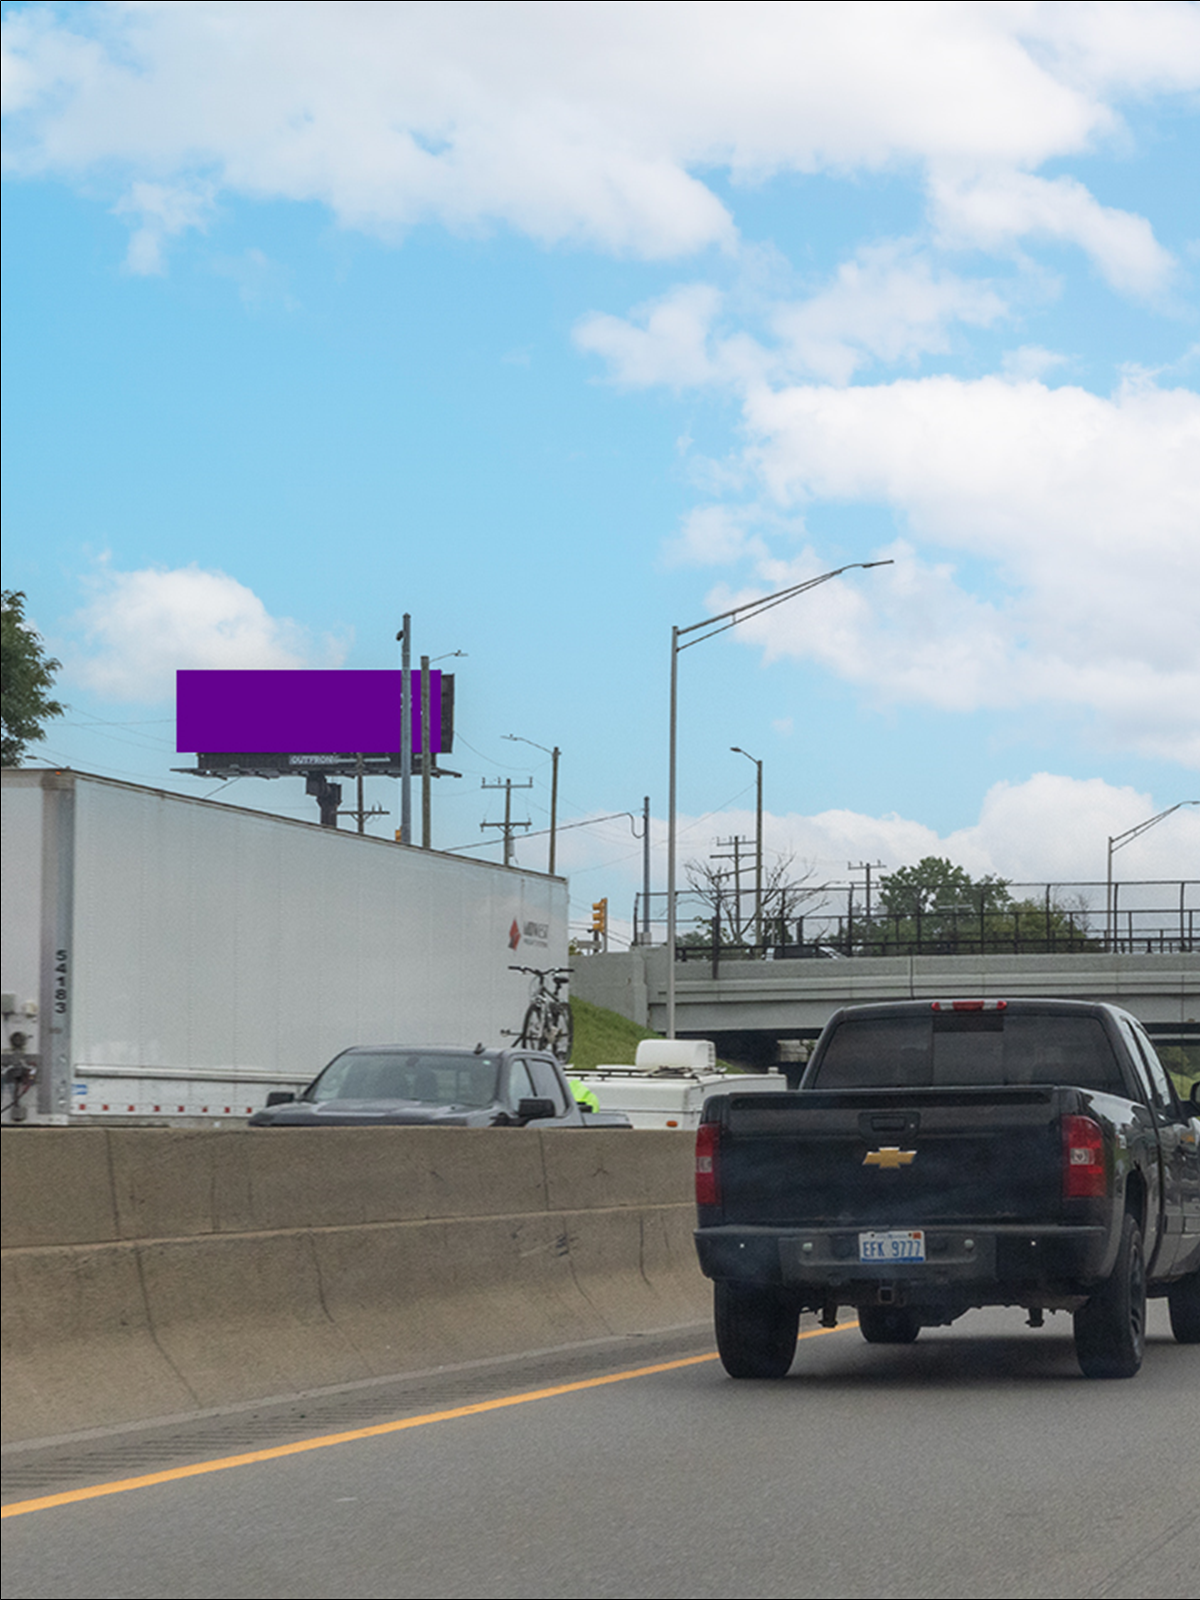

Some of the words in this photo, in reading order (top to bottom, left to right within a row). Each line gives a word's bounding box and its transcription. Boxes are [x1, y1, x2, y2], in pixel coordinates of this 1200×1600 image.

[55, 950, 67, 1014] 54183
[863, 1240, 885, 1257] EFK
[892, 1240, 921, 1257] 9777
